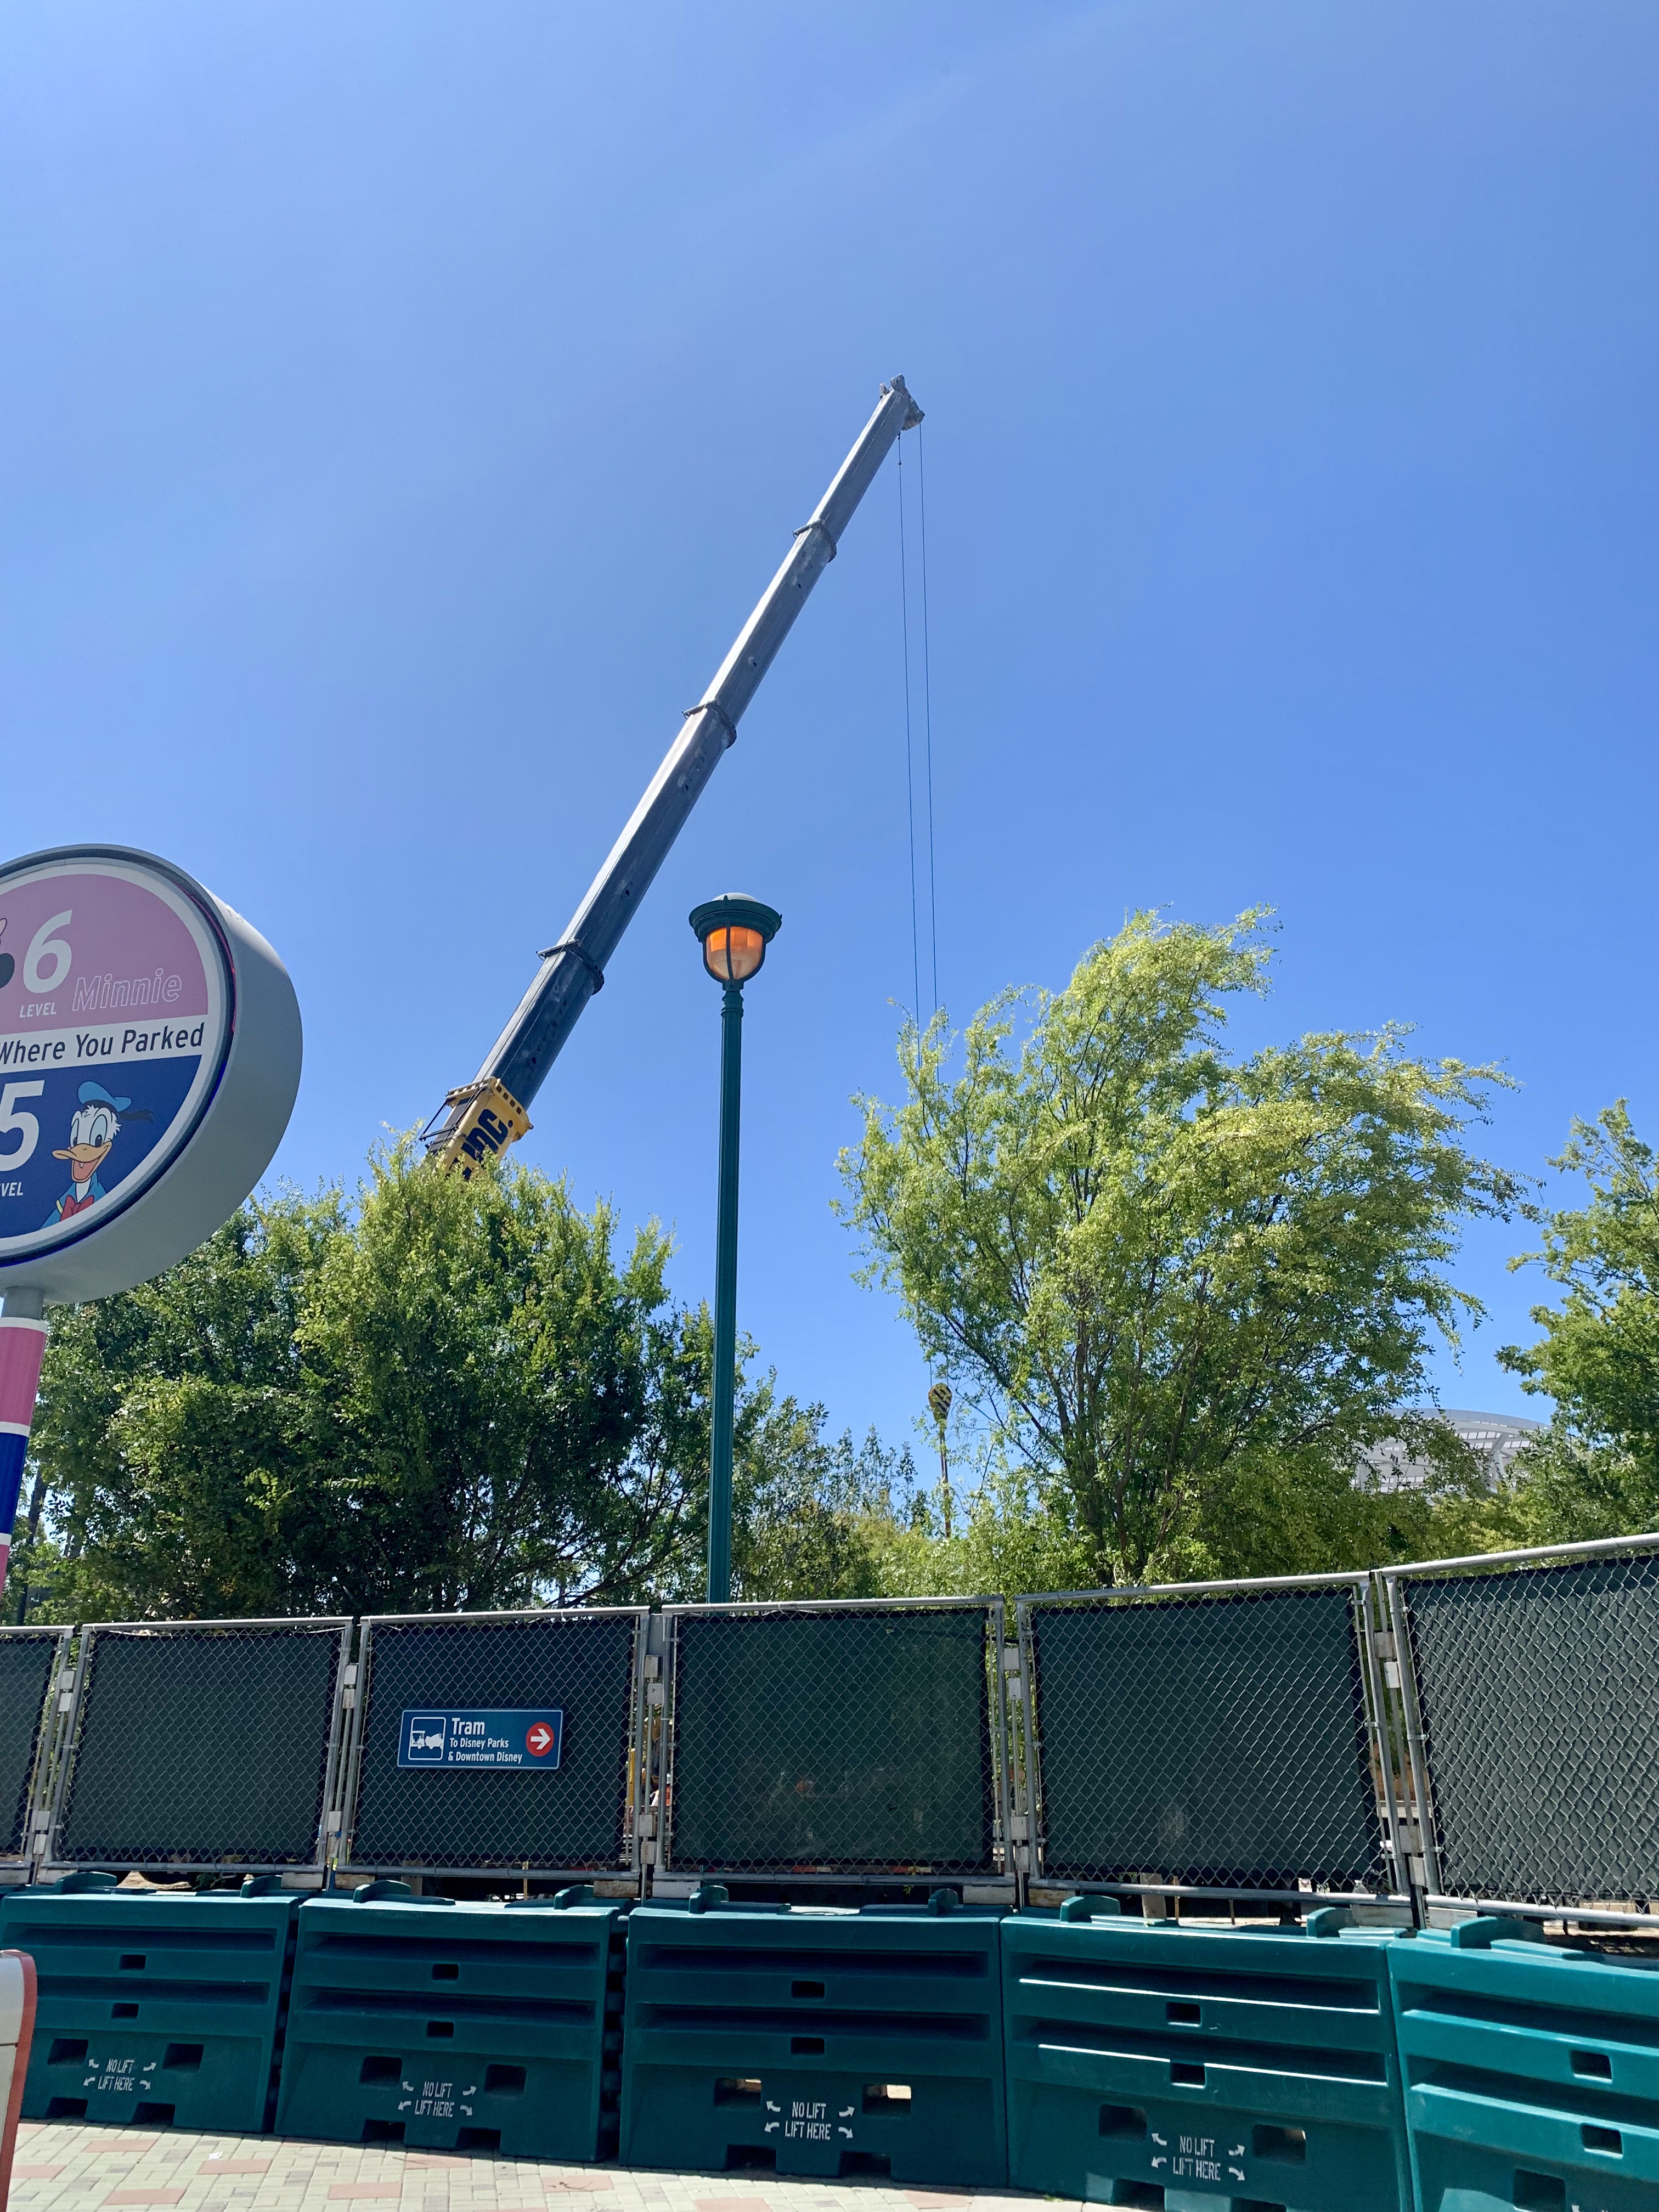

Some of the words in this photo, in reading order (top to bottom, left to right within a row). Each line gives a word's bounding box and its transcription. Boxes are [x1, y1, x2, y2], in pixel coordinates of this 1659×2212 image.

[23, 910, 72, 994] 6
[72, 968, 182, 1011] Minnie
[19, 1002, 57, 1018] LEVEL
[76, 1033, 113, 1057] You
[121, 1022, 205, 1053] Parked
[0, 1080, 45, 1171] 5
[0, 1182, 24, 1197] VEL
[452, 1717, 485, 1735] Tram
[449, 1737, 458, 1748] To
[460, 1737, 486, 1750] Disney
[487, 1737, 509, 1748] Parks
[448, 1751, 454, 1761] &
[455, 1751, 495, 1762] Downtown
[496, 1751, 523, 1764] Disney
[106, 2058, 118, 2073] NO
[117, 2059, 135, 2074] LIFT
[98, 2075, 115, 2090] LIFT
[114, 2076, 135, 2091] HERE
[422, 2081, 435, 2097] NO
[435, 2082, 453, 2098] LIFT
[414, 2100, 433, 2115] LIFT
[432, 2101, 455, 2118] HERE
[792, 2101, 805, 2118] NO
[806, 2102, 827, 2119] LIFT
[785, 2120, 805, 2138] LIFT
[806, 2122, 831, 2141] HERE
[1180, 2135, 1192, 2154] NO
[1195, 2137, 1215, 2158] LIFT
[1173, 2157, 1194, 2177] LIFT
[1196, 2159, 1221, 2181] HERE
